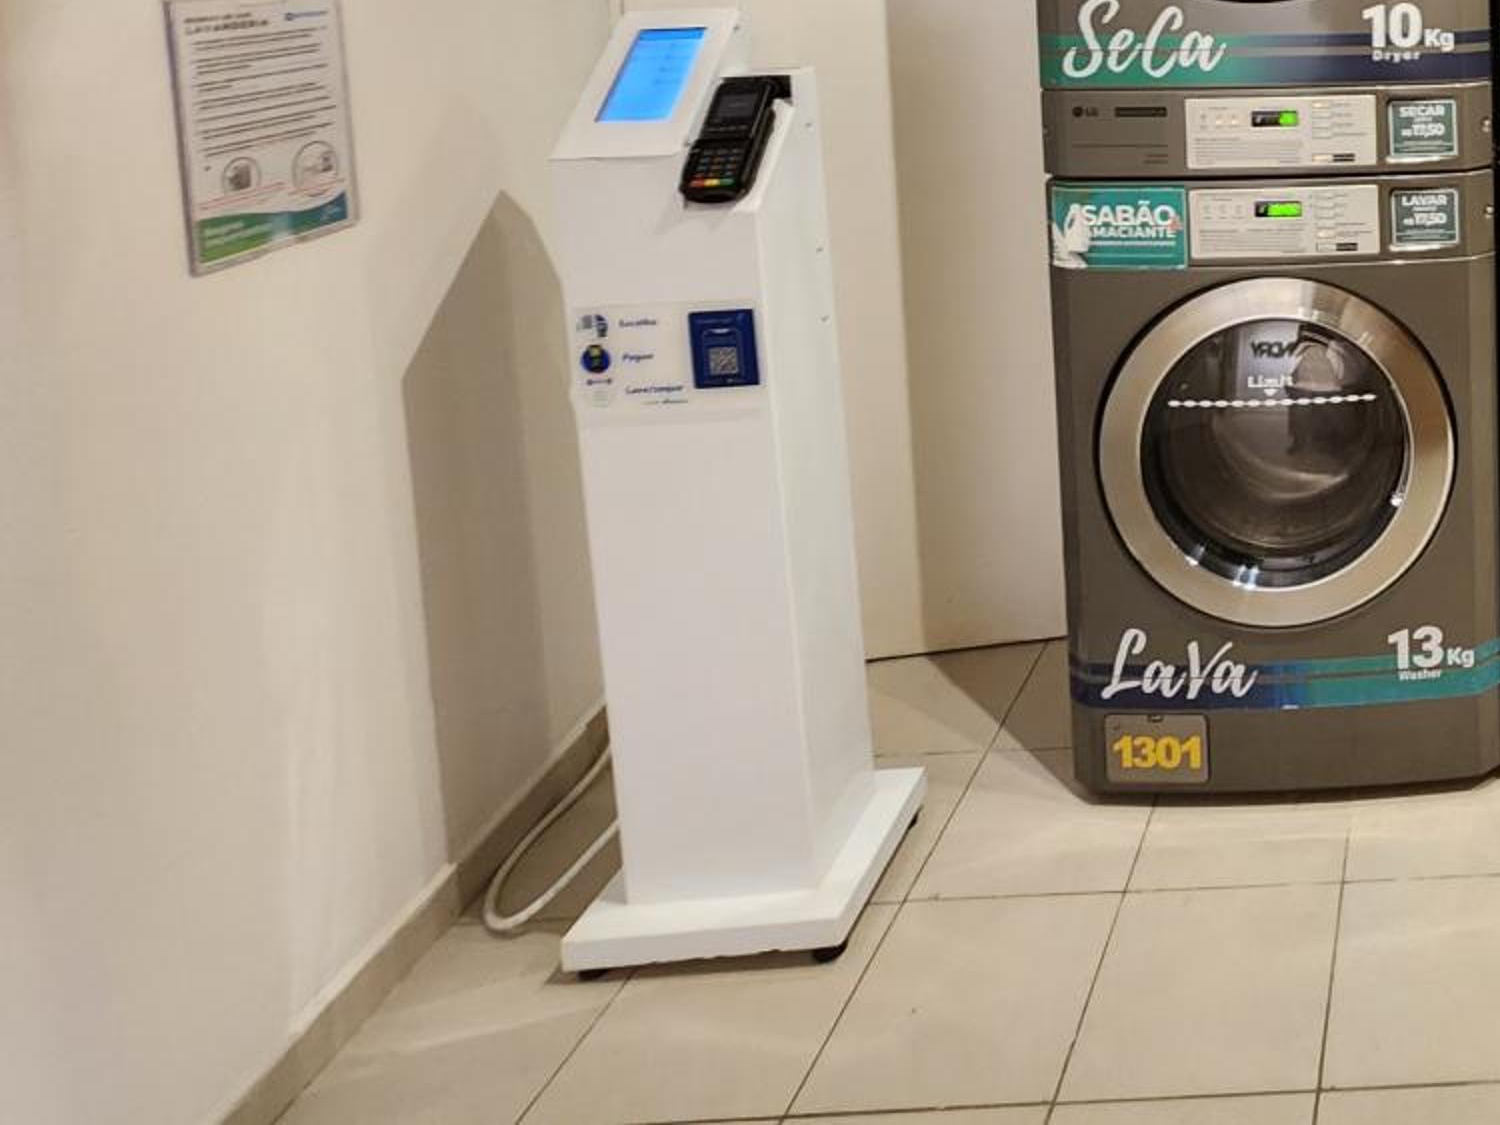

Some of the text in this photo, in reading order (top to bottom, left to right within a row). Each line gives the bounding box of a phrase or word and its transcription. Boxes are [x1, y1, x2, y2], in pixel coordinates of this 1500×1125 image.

[1362, 2, 1455, 52] 10 Kg
[1372, 49, 1421, 63] Dryer
[1084, 200, 1176, 226] SABÃO
[1101, 628, 1259, 700] LaVa
[1387, 625, 1475, 669] 13 Kg
[1112, 735, 1201, 769] 1301
